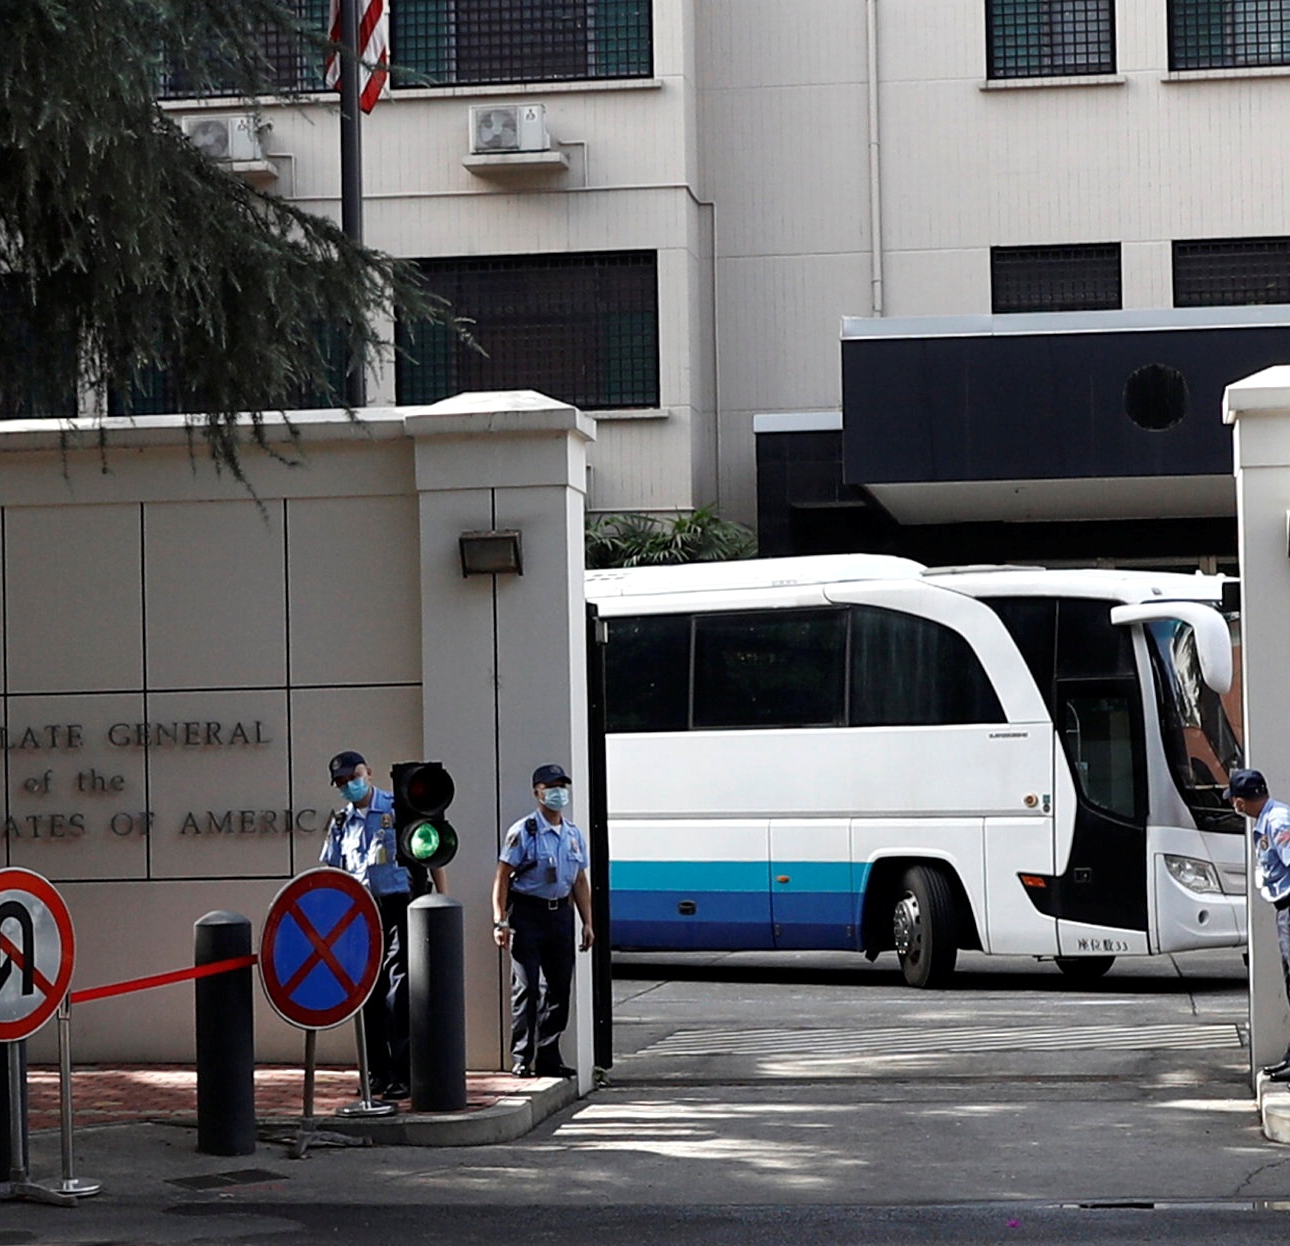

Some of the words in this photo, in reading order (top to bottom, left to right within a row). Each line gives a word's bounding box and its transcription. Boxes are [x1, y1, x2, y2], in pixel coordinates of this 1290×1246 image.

[108, 721, 273, 748] GENERAL
[24, 769, 53, 793] of
[77, 768, 125, 792] the
[111, 811, 155, 836] OF
